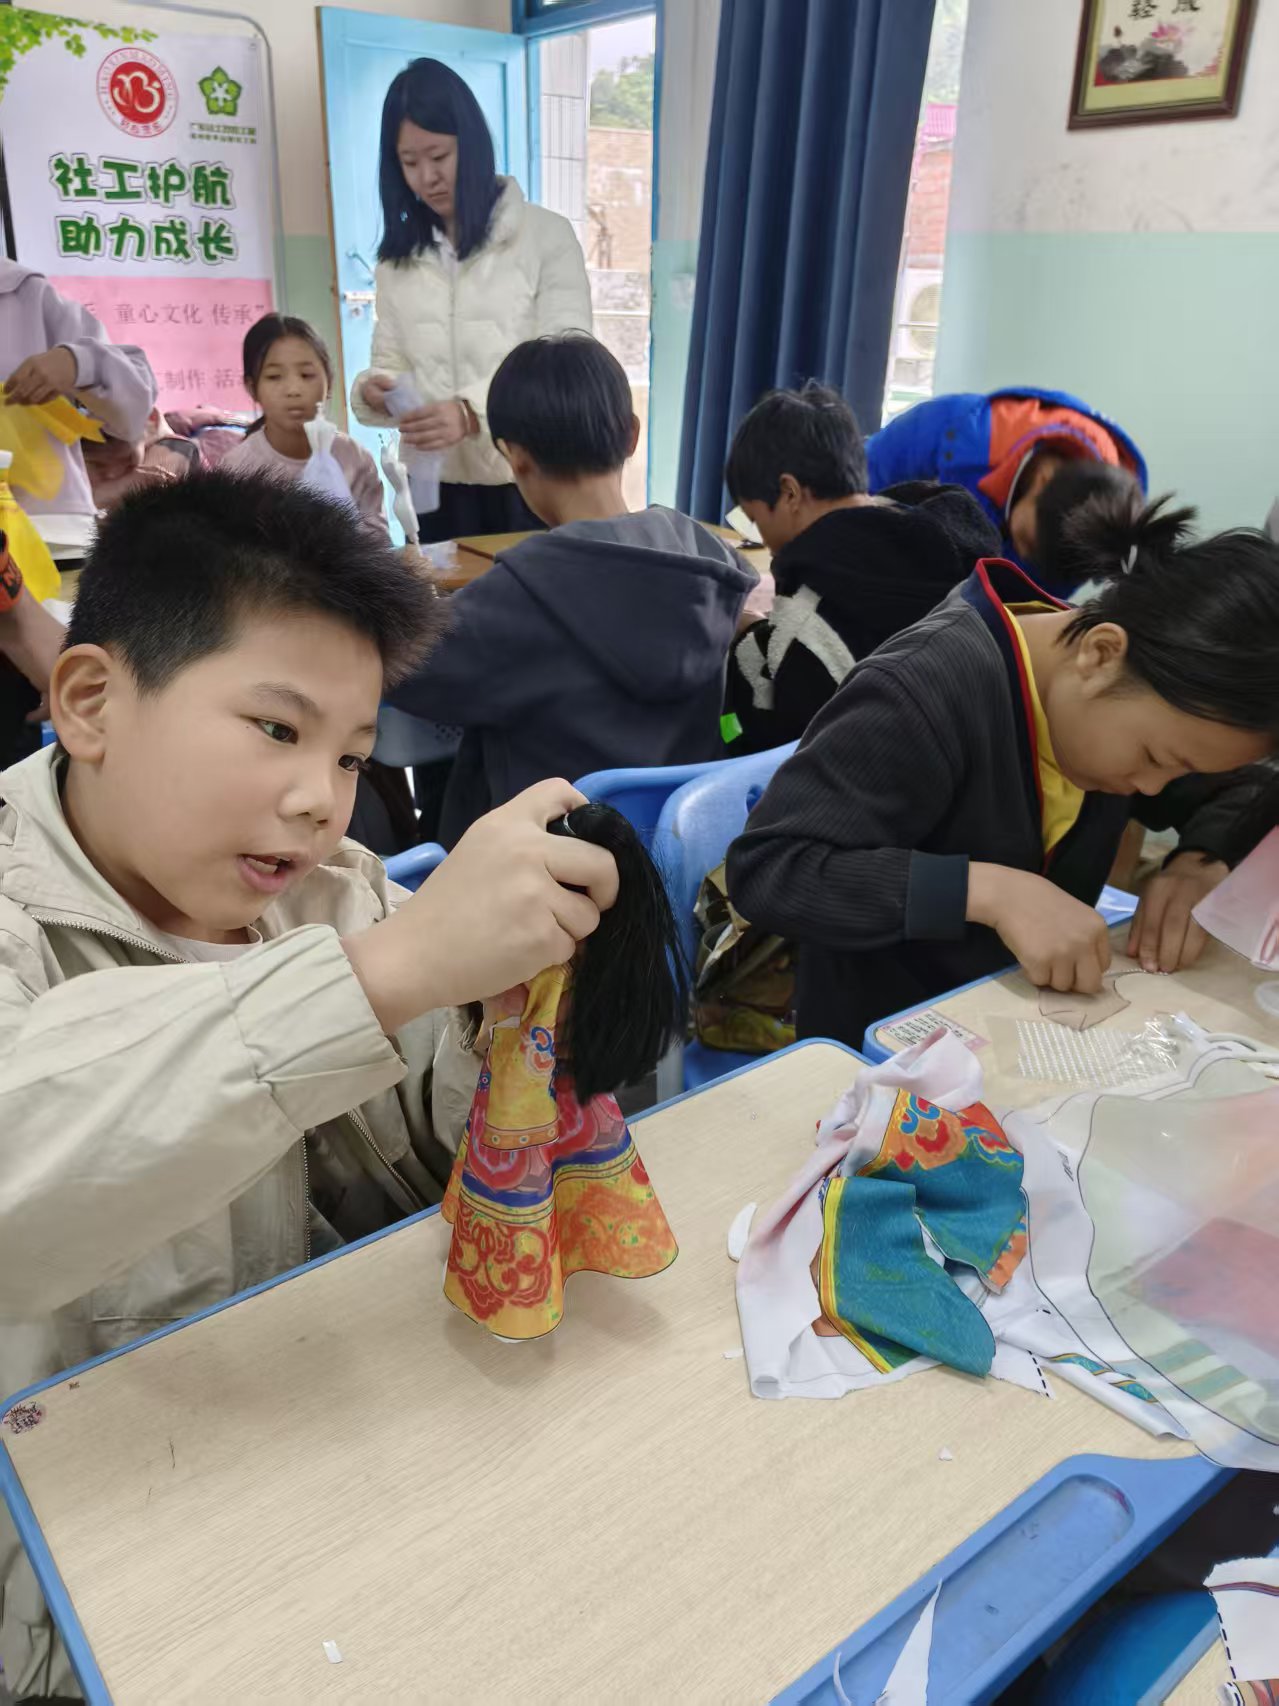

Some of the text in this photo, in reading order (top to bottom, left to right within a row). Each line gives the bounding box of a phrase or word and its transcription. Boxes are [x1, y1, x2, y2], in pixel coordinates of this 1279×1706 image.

[52, 155, 234, 208] 社工护航
[57, 214, 235, 262] 助力成长
[115, 303, 203, 325] 童心文化
